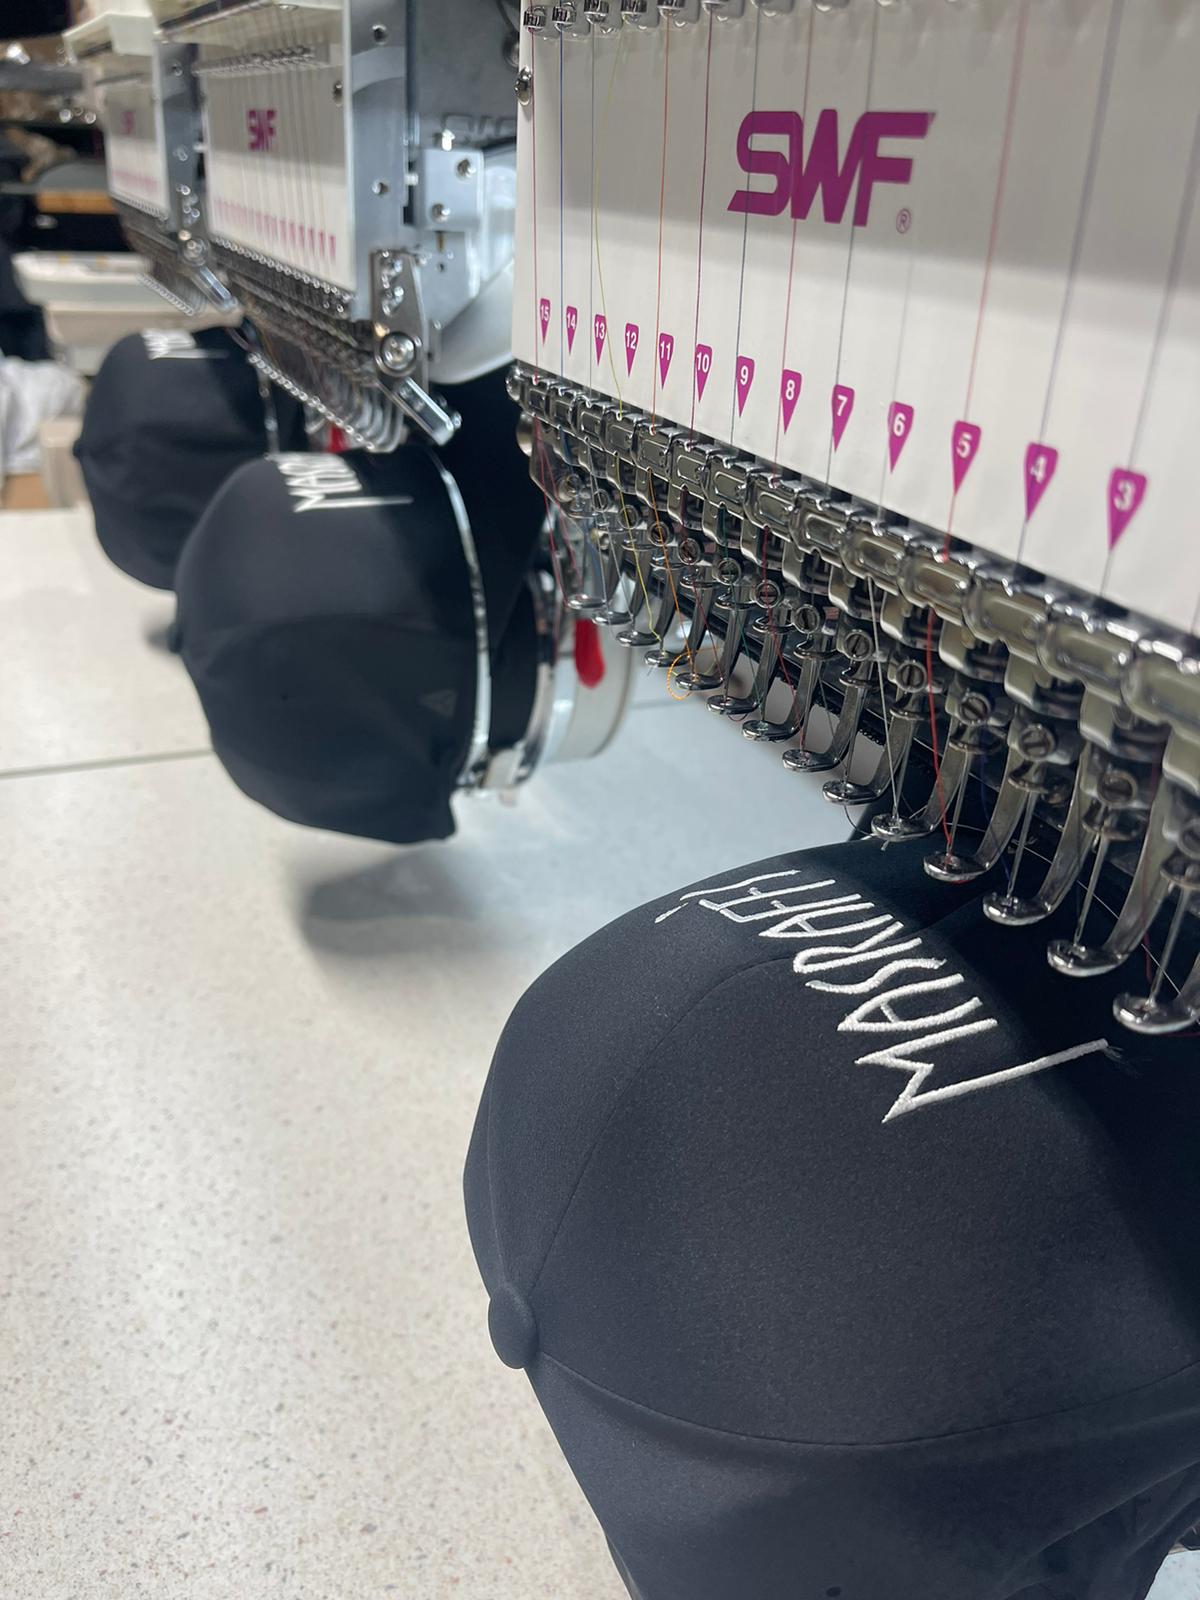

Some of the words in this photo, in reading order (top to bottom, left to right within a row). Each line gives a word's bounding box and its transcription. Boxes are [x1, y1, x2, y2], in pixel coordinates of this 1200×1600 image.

[727, 109, 936, 227] SWF
[540, 304, 550, 321] 15
[566, 313, 577, 329] 14
[595, 320, 606, 337] 13
[625, 331, 638, 349] 12
[661, 341, 673, 361] 11
[696, 352, 711, 374] 10
[739, 364, 750, 386] 9
[784, 378, 797, 401] 8
[835, 394, 849, 417] 7
[892, 411, 907, 437] 6
[955, 432, 972, 459] 5
[1029, 454, 1049, 484] 4
[1112, 478, 1137, 512] 3
